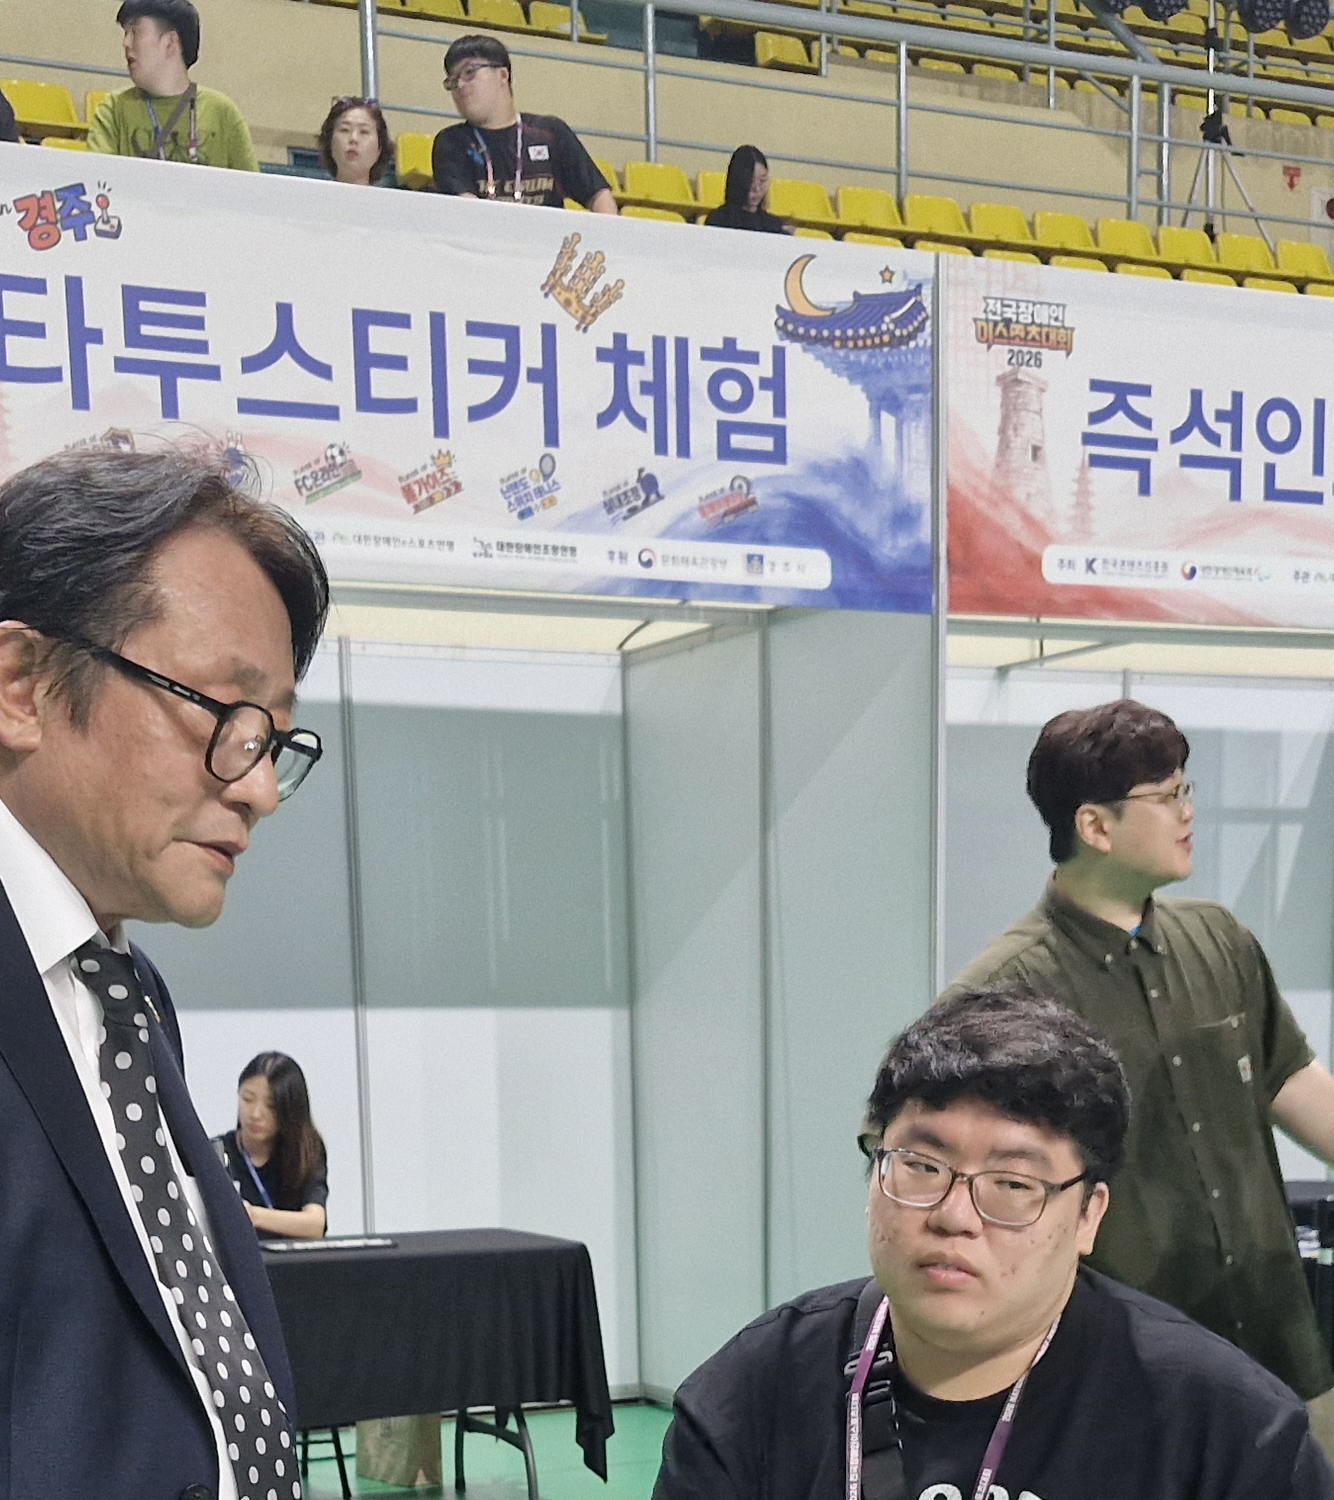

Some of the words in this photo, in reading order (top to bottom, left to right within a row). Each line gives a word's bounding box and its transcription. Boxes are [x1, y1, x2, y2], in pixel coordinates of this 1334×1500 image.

[14, 183, 96, 250] 경주
[984, 298, 1065, 327] 전국장애인
[1007, 349, 1043, 368] 2026
[596, 331, 787, 466] 체험
